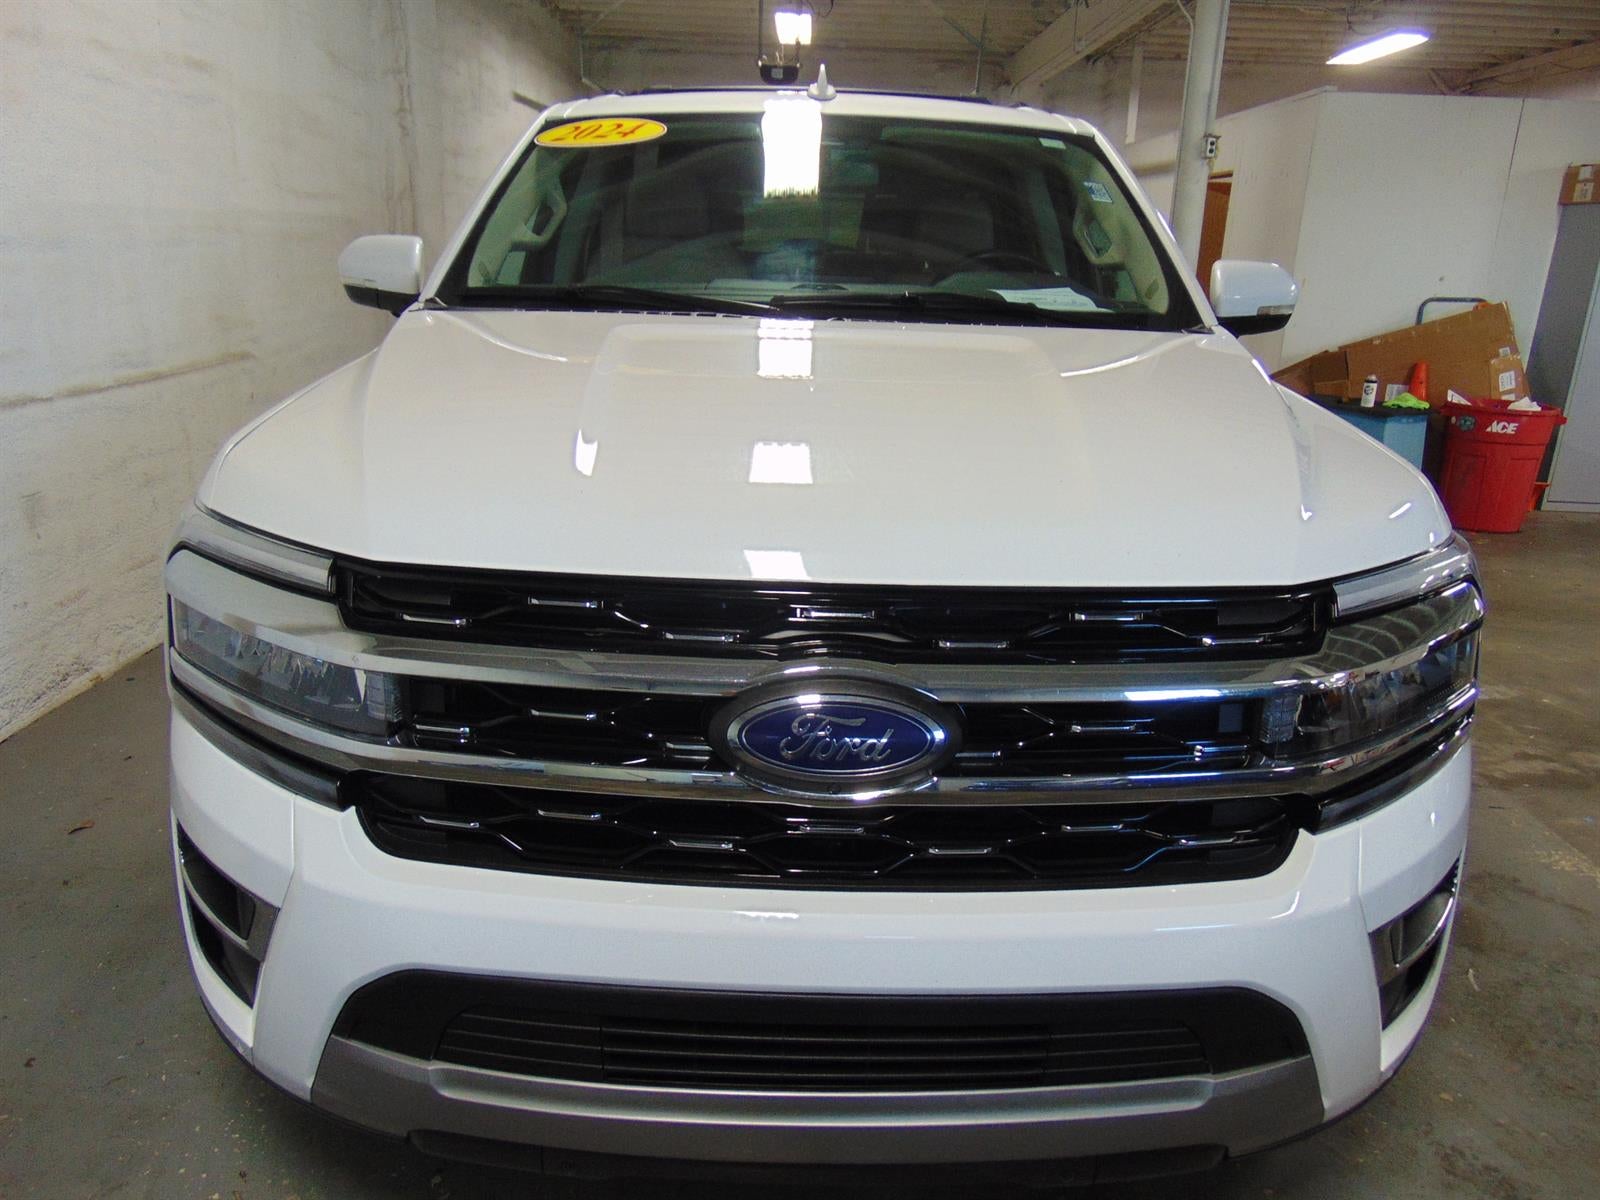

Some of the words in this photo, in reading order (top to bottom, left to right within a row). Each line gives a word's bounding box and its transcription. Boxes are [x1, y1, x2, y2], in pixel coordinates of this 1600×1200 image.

[551, 122, 647, 142] 2024
[1485, 420, 1519, 434] ACE
[779, 713, 895, 762] Ford
